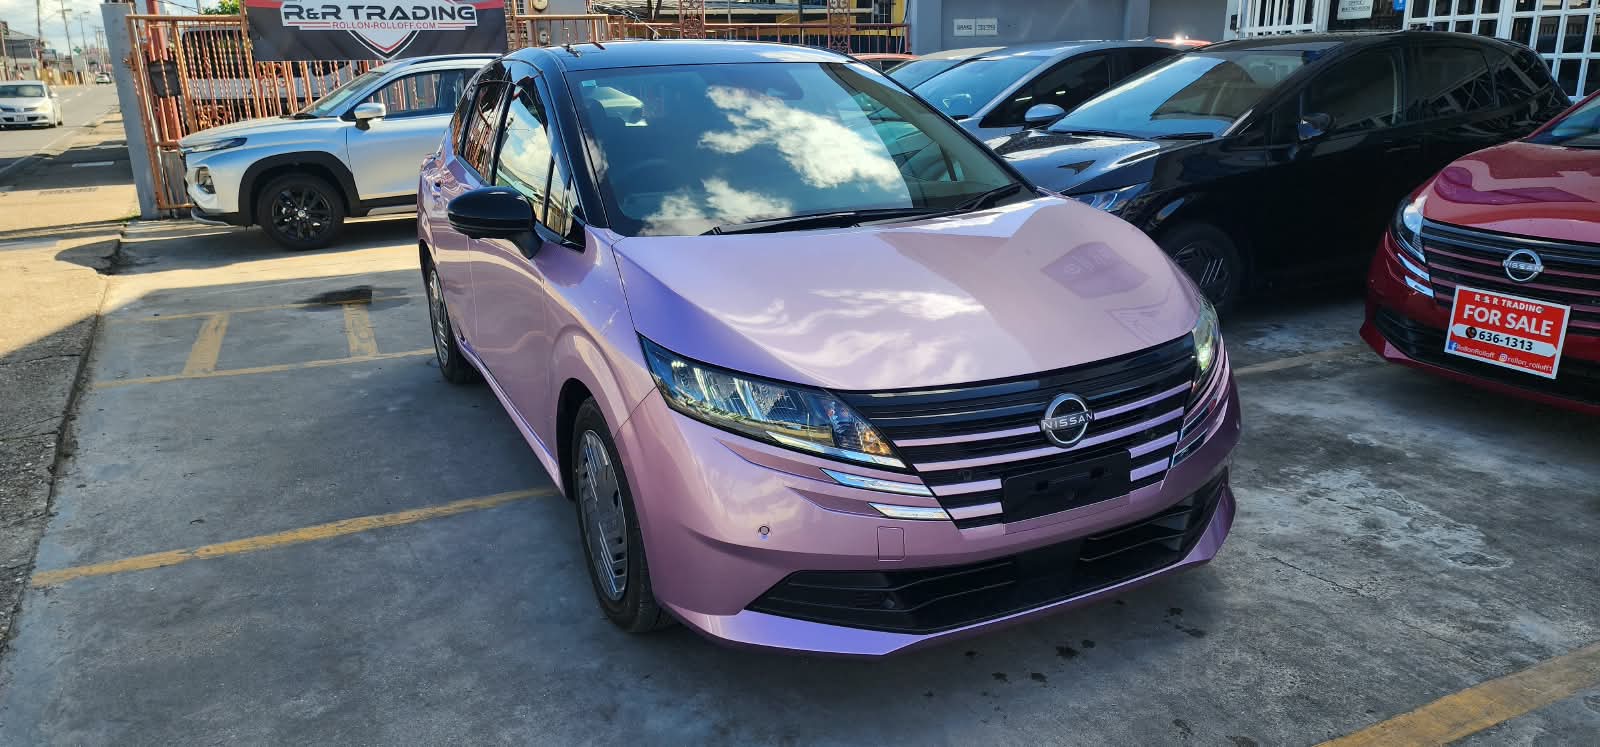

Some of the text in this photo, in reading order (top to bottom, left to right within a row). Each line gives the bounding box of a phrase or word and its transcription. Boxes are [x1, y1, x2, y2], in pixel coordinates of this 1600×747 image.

[283, 4, 476, 21] R&R TRADING
[332, 21, 437, 30] ROLLON-ROLLOFF.COM
[1503, 260, 1544, 272] NISSAN
[1474, 294, 1481, 302] R
[1492, 298, 1500, 306] R
[1501, 299, 1543, 314] TRADING
[1463, 304, 1554, 336] FOR SALE
[1479, 331, 1533, 351] 636-1313
[1042, 410, 1093, 430] NISSAN
